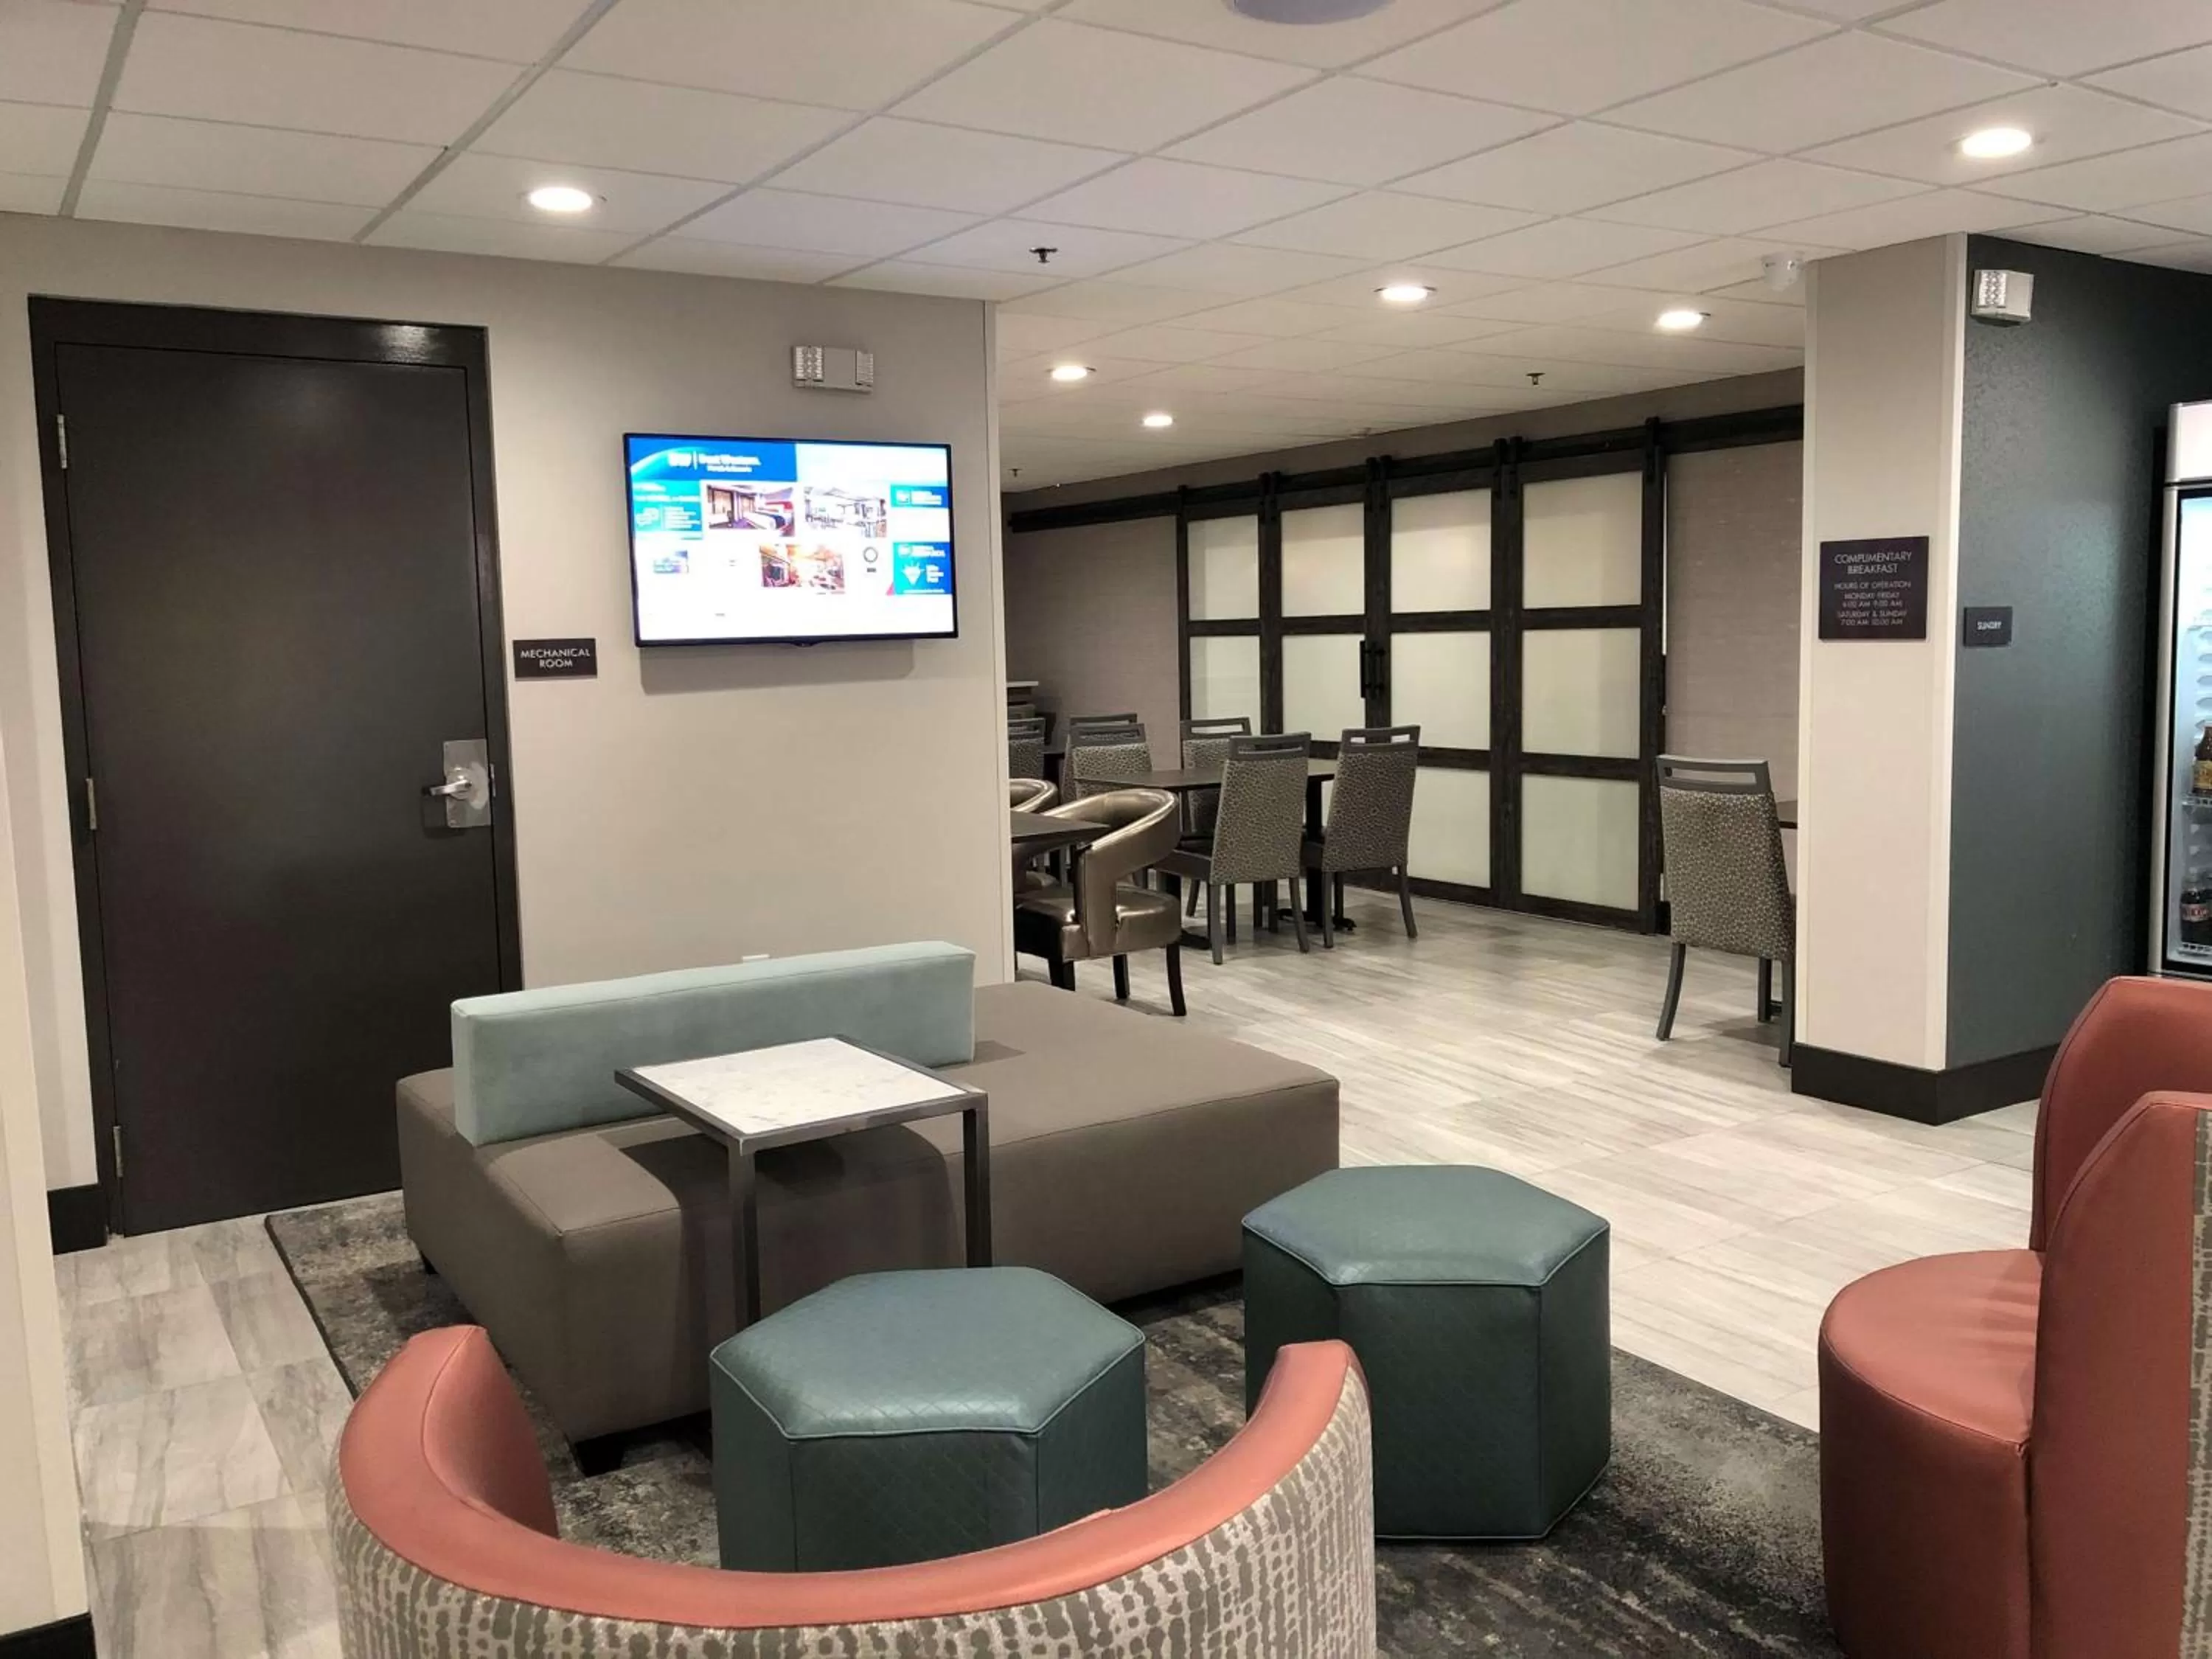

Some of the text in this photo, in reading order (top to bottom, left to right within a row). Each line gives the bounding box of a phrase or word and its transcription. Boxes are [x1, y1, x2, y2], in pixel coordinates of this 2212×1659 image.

[1834, 551, 1912, 564] COMPLIMENTARY
[1847, 563, 1898, 574] BREAKFAST
[520, 648, 591, 658] MECHANICAL
[539, 658, 573, 668] ROOM
